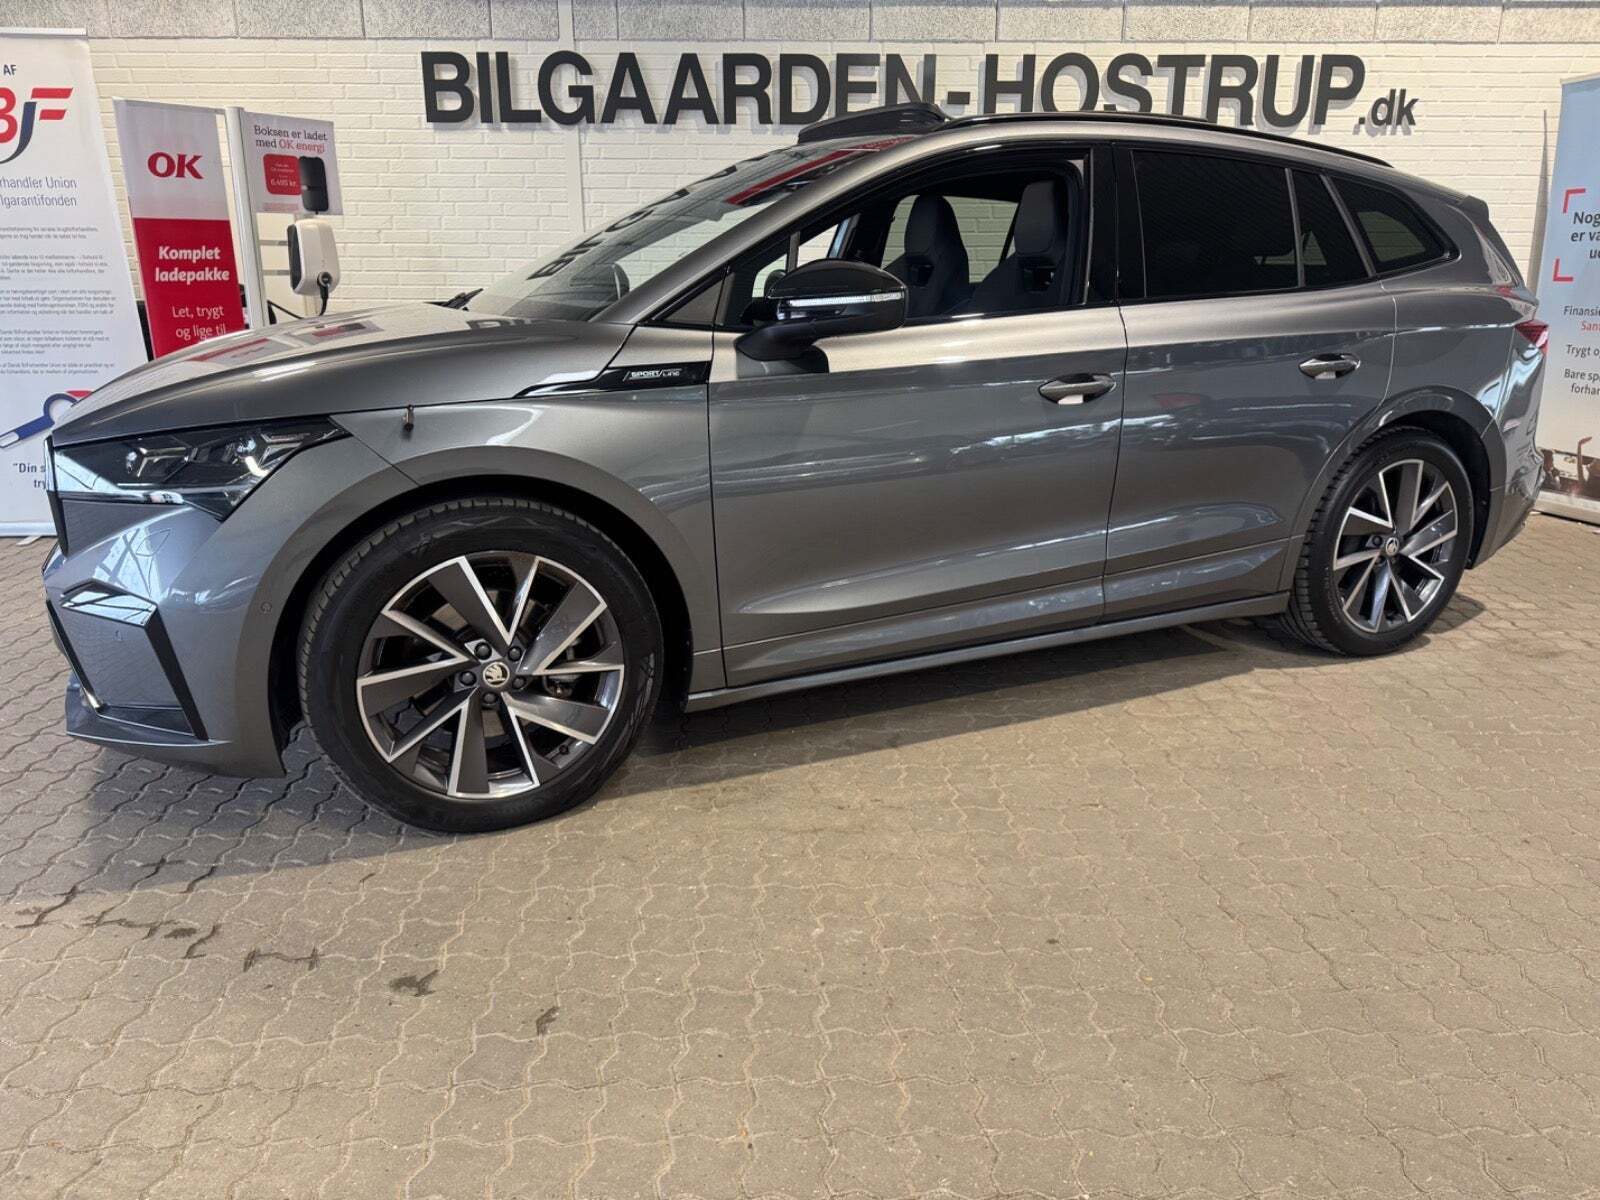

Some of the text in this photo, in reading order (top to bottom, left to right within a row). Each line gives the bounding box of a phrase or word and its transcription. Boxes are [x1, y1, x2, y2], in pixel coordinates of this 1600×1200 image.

[3, 64, 17, 76] AF
[254, 125, 289, 138] Boksen
[291, 130, 302, 139] er
[255, 138, 325, 154] med OK energi
[147, 151, 204, 180] OK
[45, 176, 77, 189] Union
[1571, 231, 1586, 242] er
[158, 246, 221, 263] Komplet
[155, 267, 230, 285] ladepakke
[172, 305, 225, 320] Let, trygt
[175, 323, 227, 341] og lige til
[1566, 344, 1591, 358] Trygt
[1564, 368, 1586, 380] Bare
